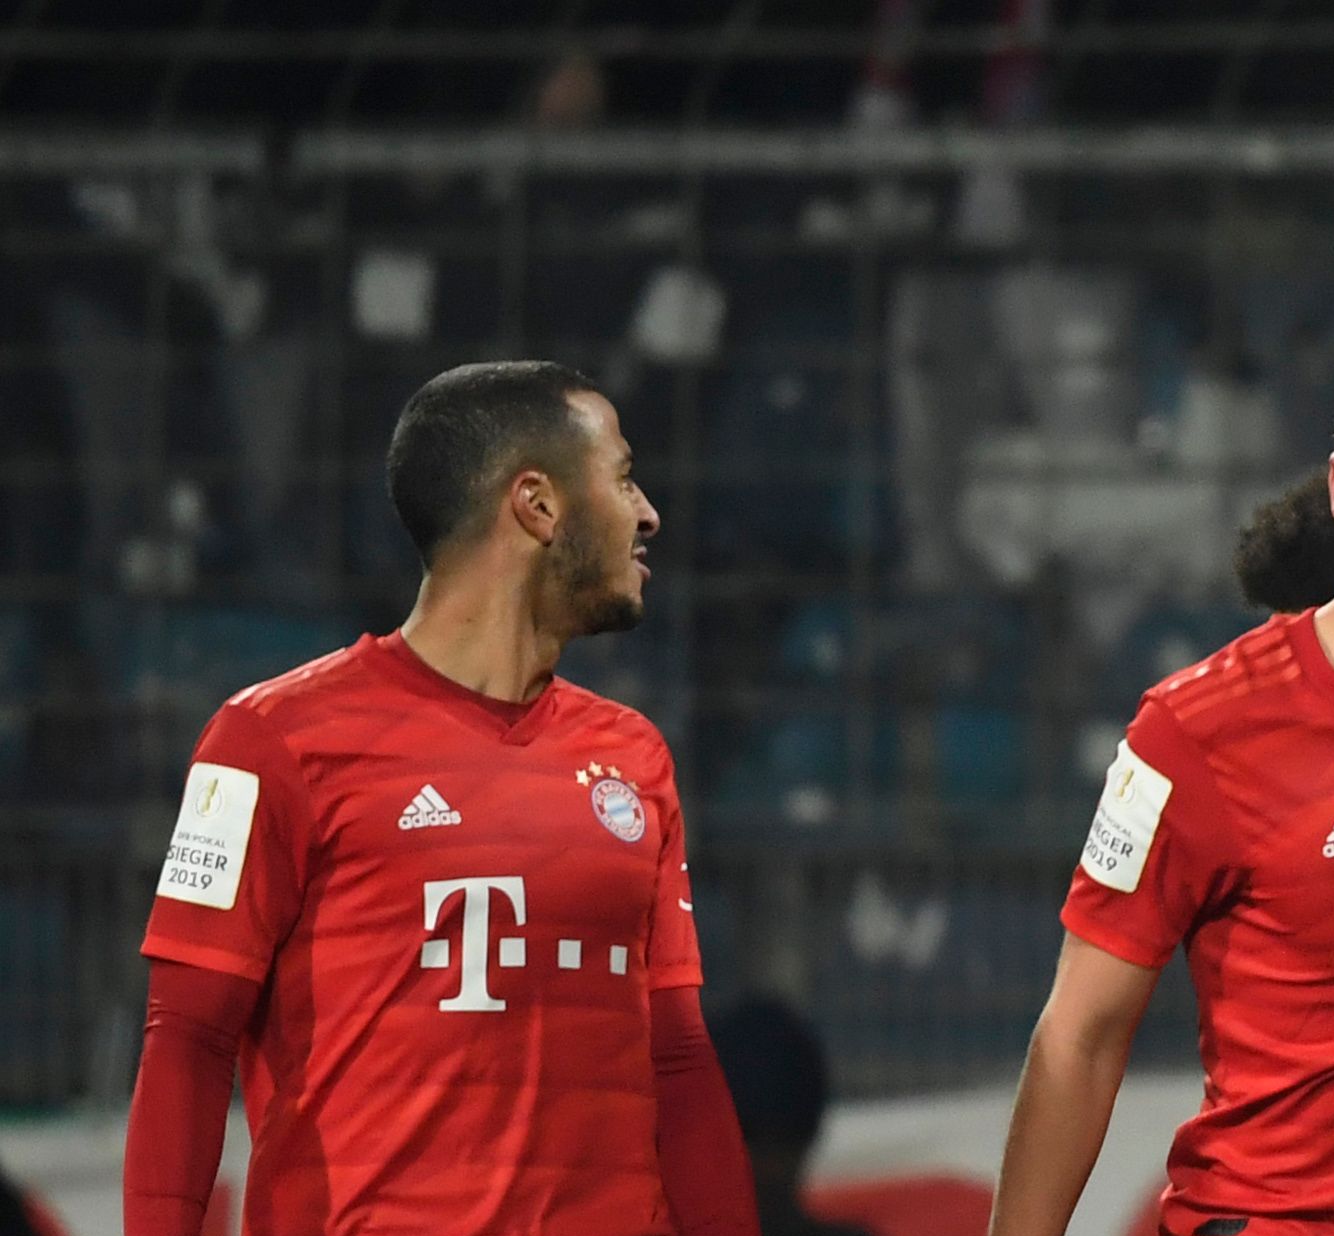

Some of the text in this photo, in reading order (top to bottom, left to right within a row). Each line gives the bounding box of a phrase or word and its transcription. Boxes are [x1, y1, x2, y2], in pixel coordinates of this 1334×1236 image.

[398, 809, 462, 830] adidas
[166, 844, 229, 872] SIEGER
[168, 867, 214, 890] 2019
